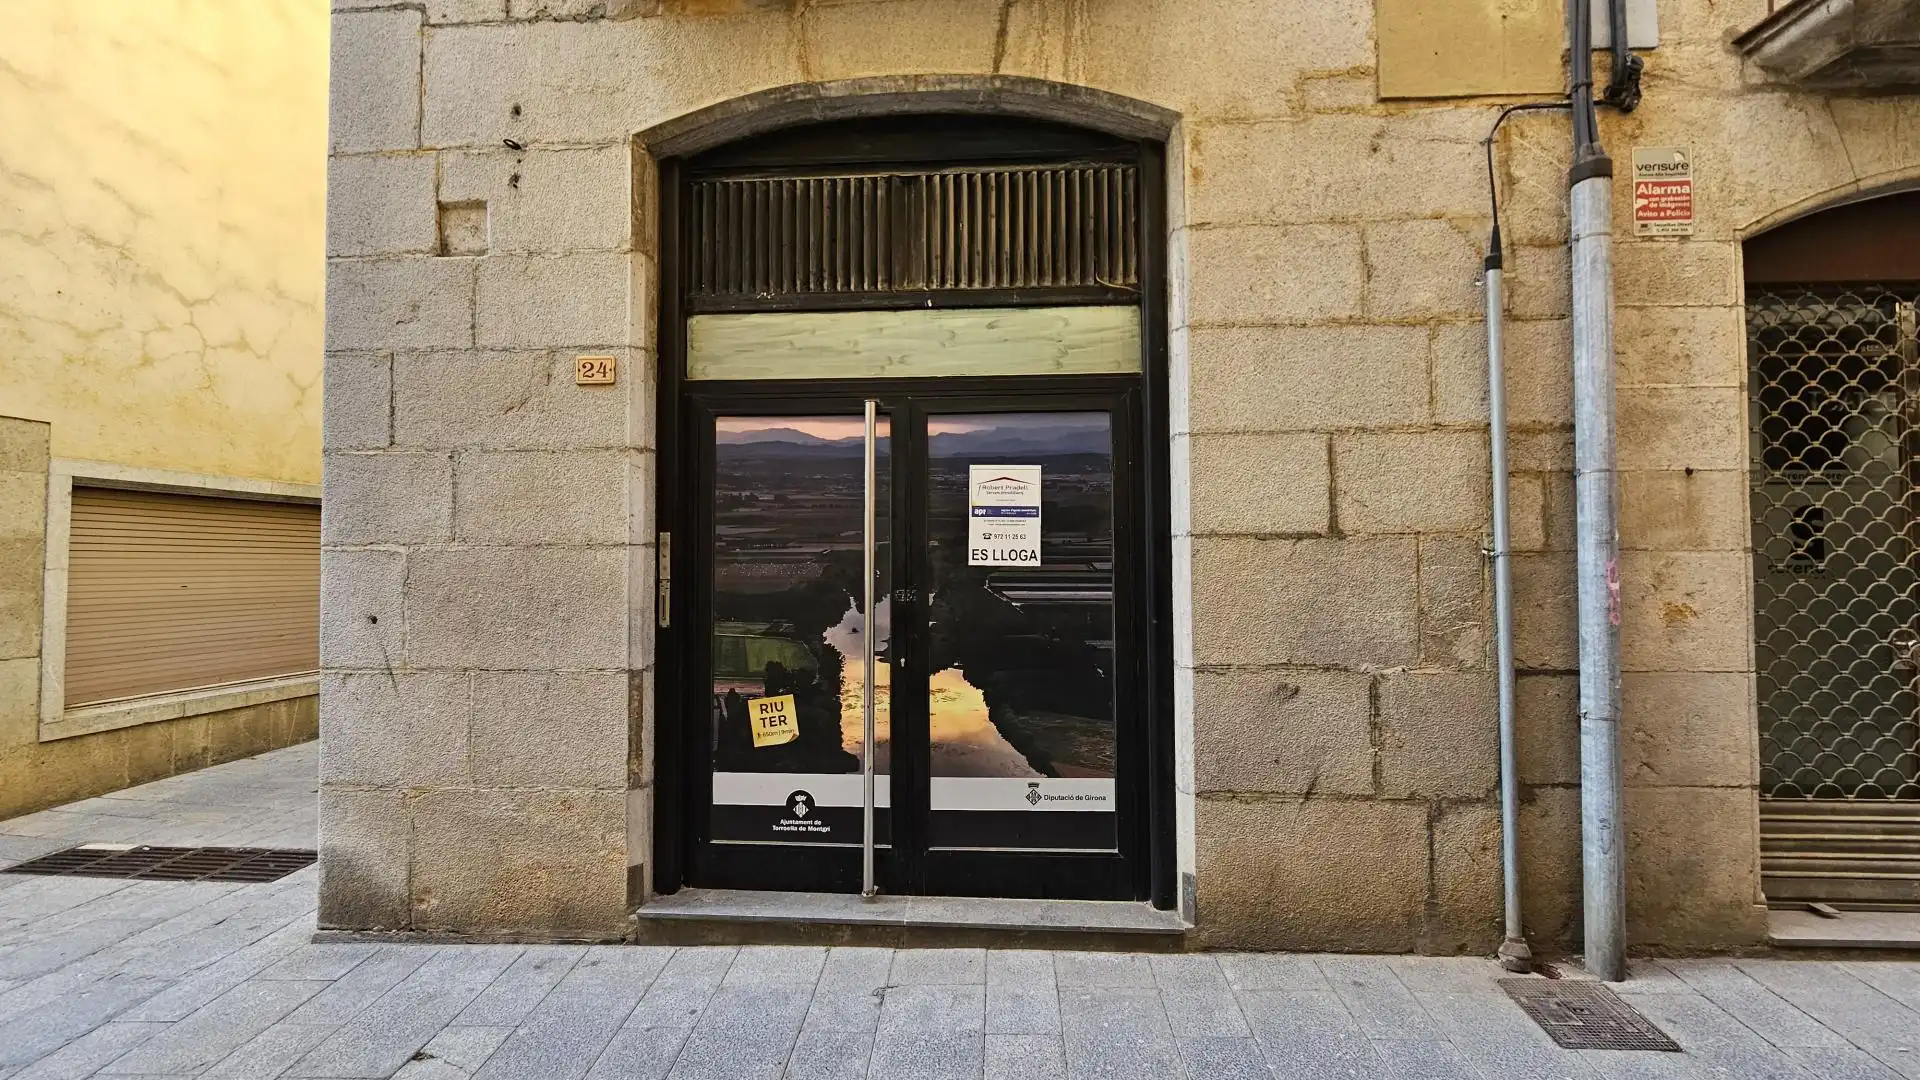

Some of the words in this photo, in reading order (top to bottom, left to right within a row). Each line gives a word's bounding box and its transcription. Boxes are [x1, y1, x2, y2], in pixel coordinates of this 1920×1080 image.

[1636, 162, 1689, 172] verisure
[1636, 183, 1690, 194] Alarma
[582, 362, 608, 378] 24
[972, 548, 988, 561] ES
[992, 548, 1038, 562] LLOGA
[760, 701, 784, 714] RIU
[760, 714, 788, 728] TER
